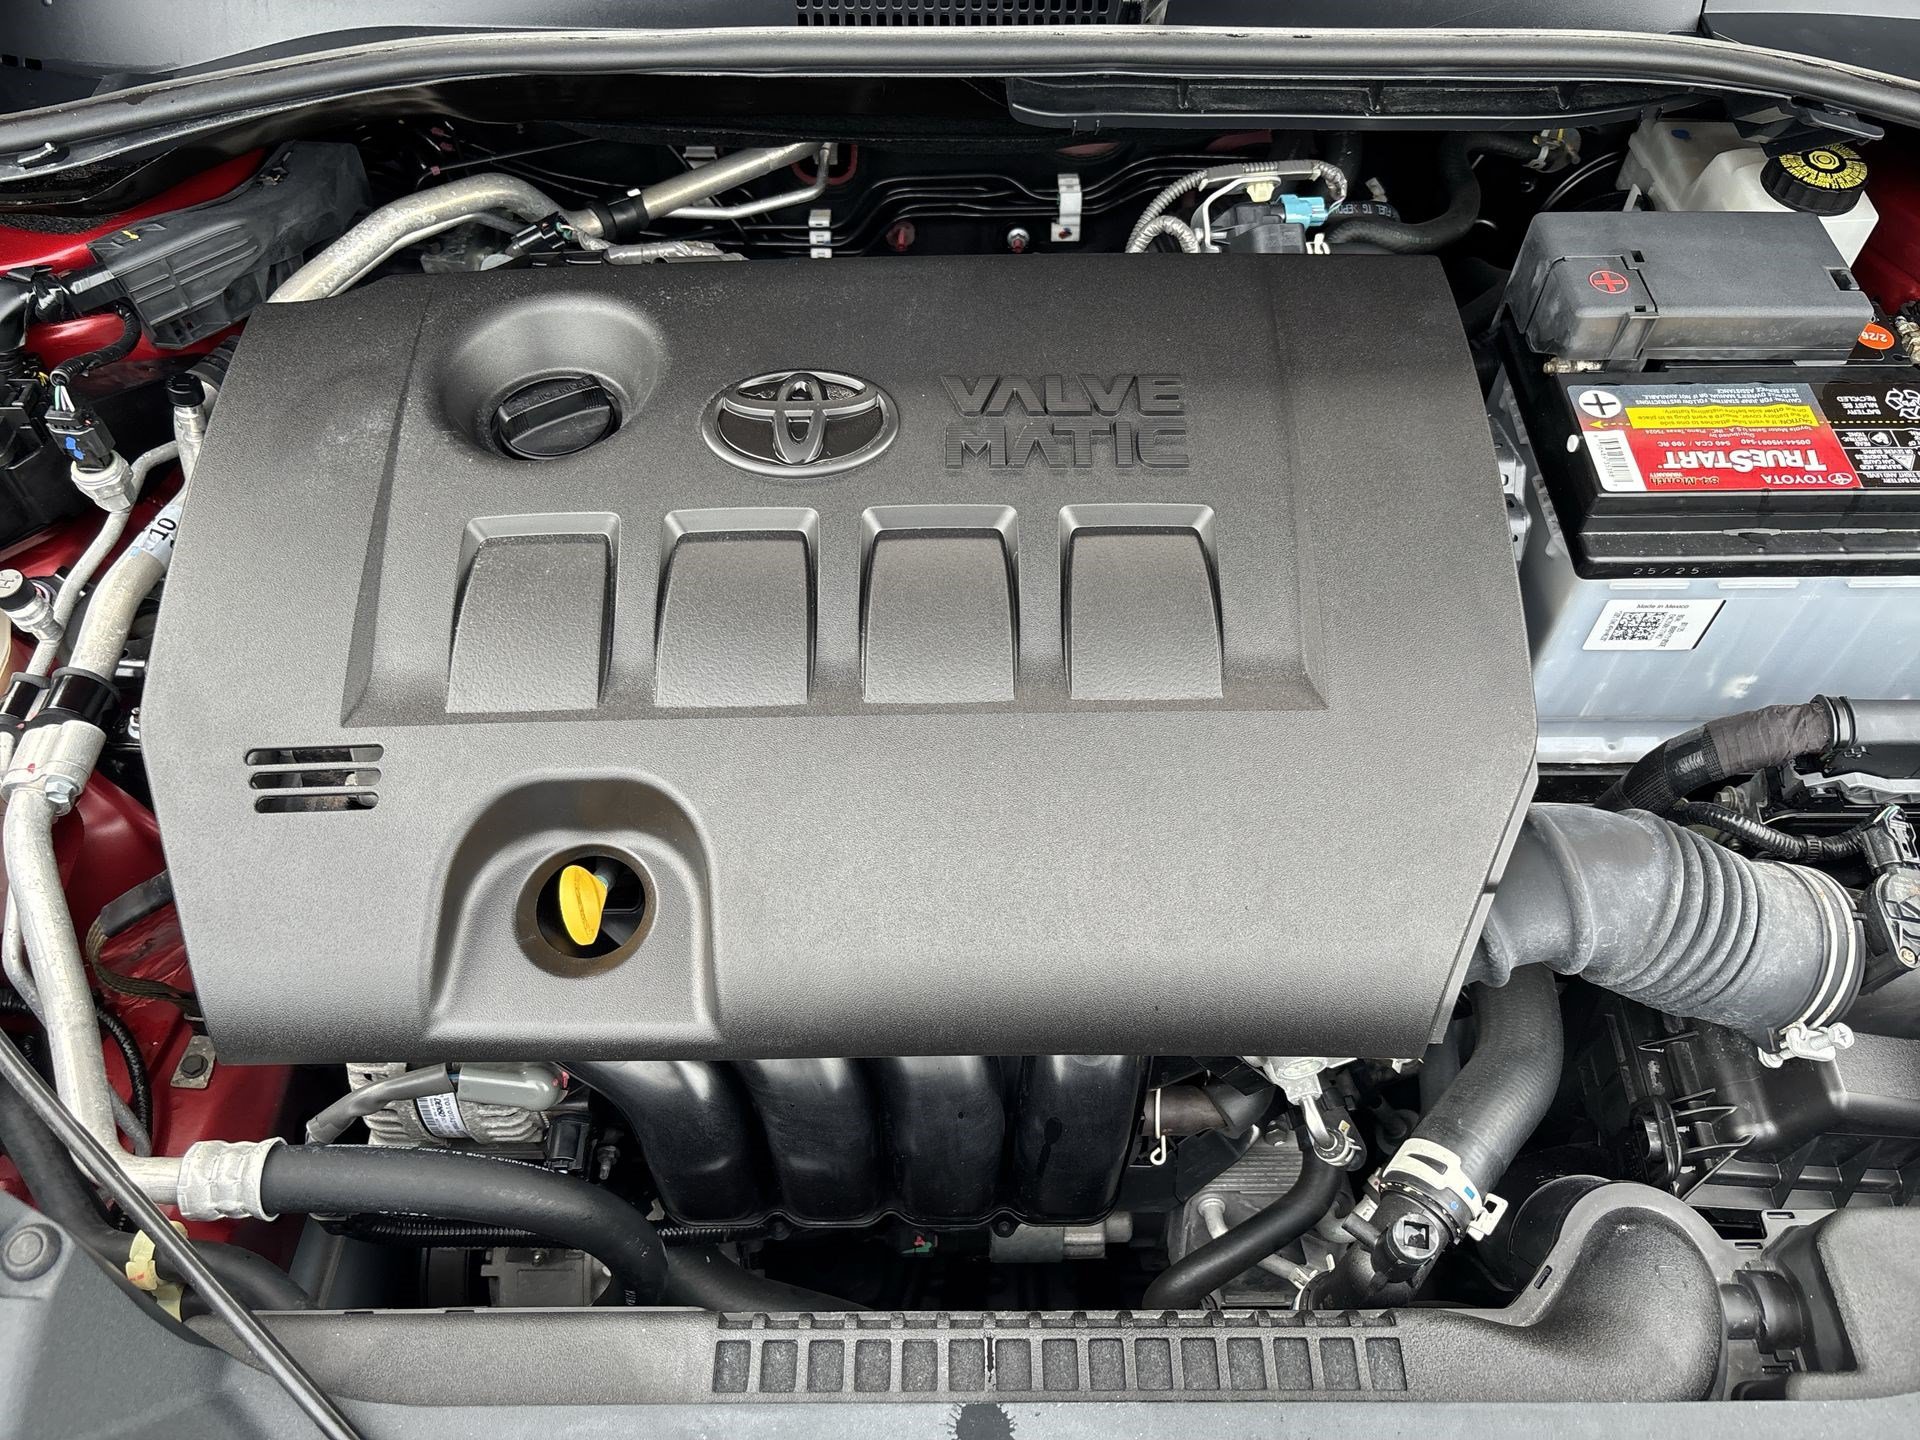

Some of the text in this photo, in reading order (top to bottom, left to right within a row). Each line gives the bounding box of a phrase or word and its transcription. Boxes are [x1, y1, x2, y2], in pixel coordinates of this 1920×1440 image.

[941, 374, 1185, 417] VALVE
[945, 421, 1189, 469] MATIC
[1650, 475, 1719, 486] 84-Month
[1760, 474, 1828, 484] TOYOTA
[149, 517, 177, 541] 10
